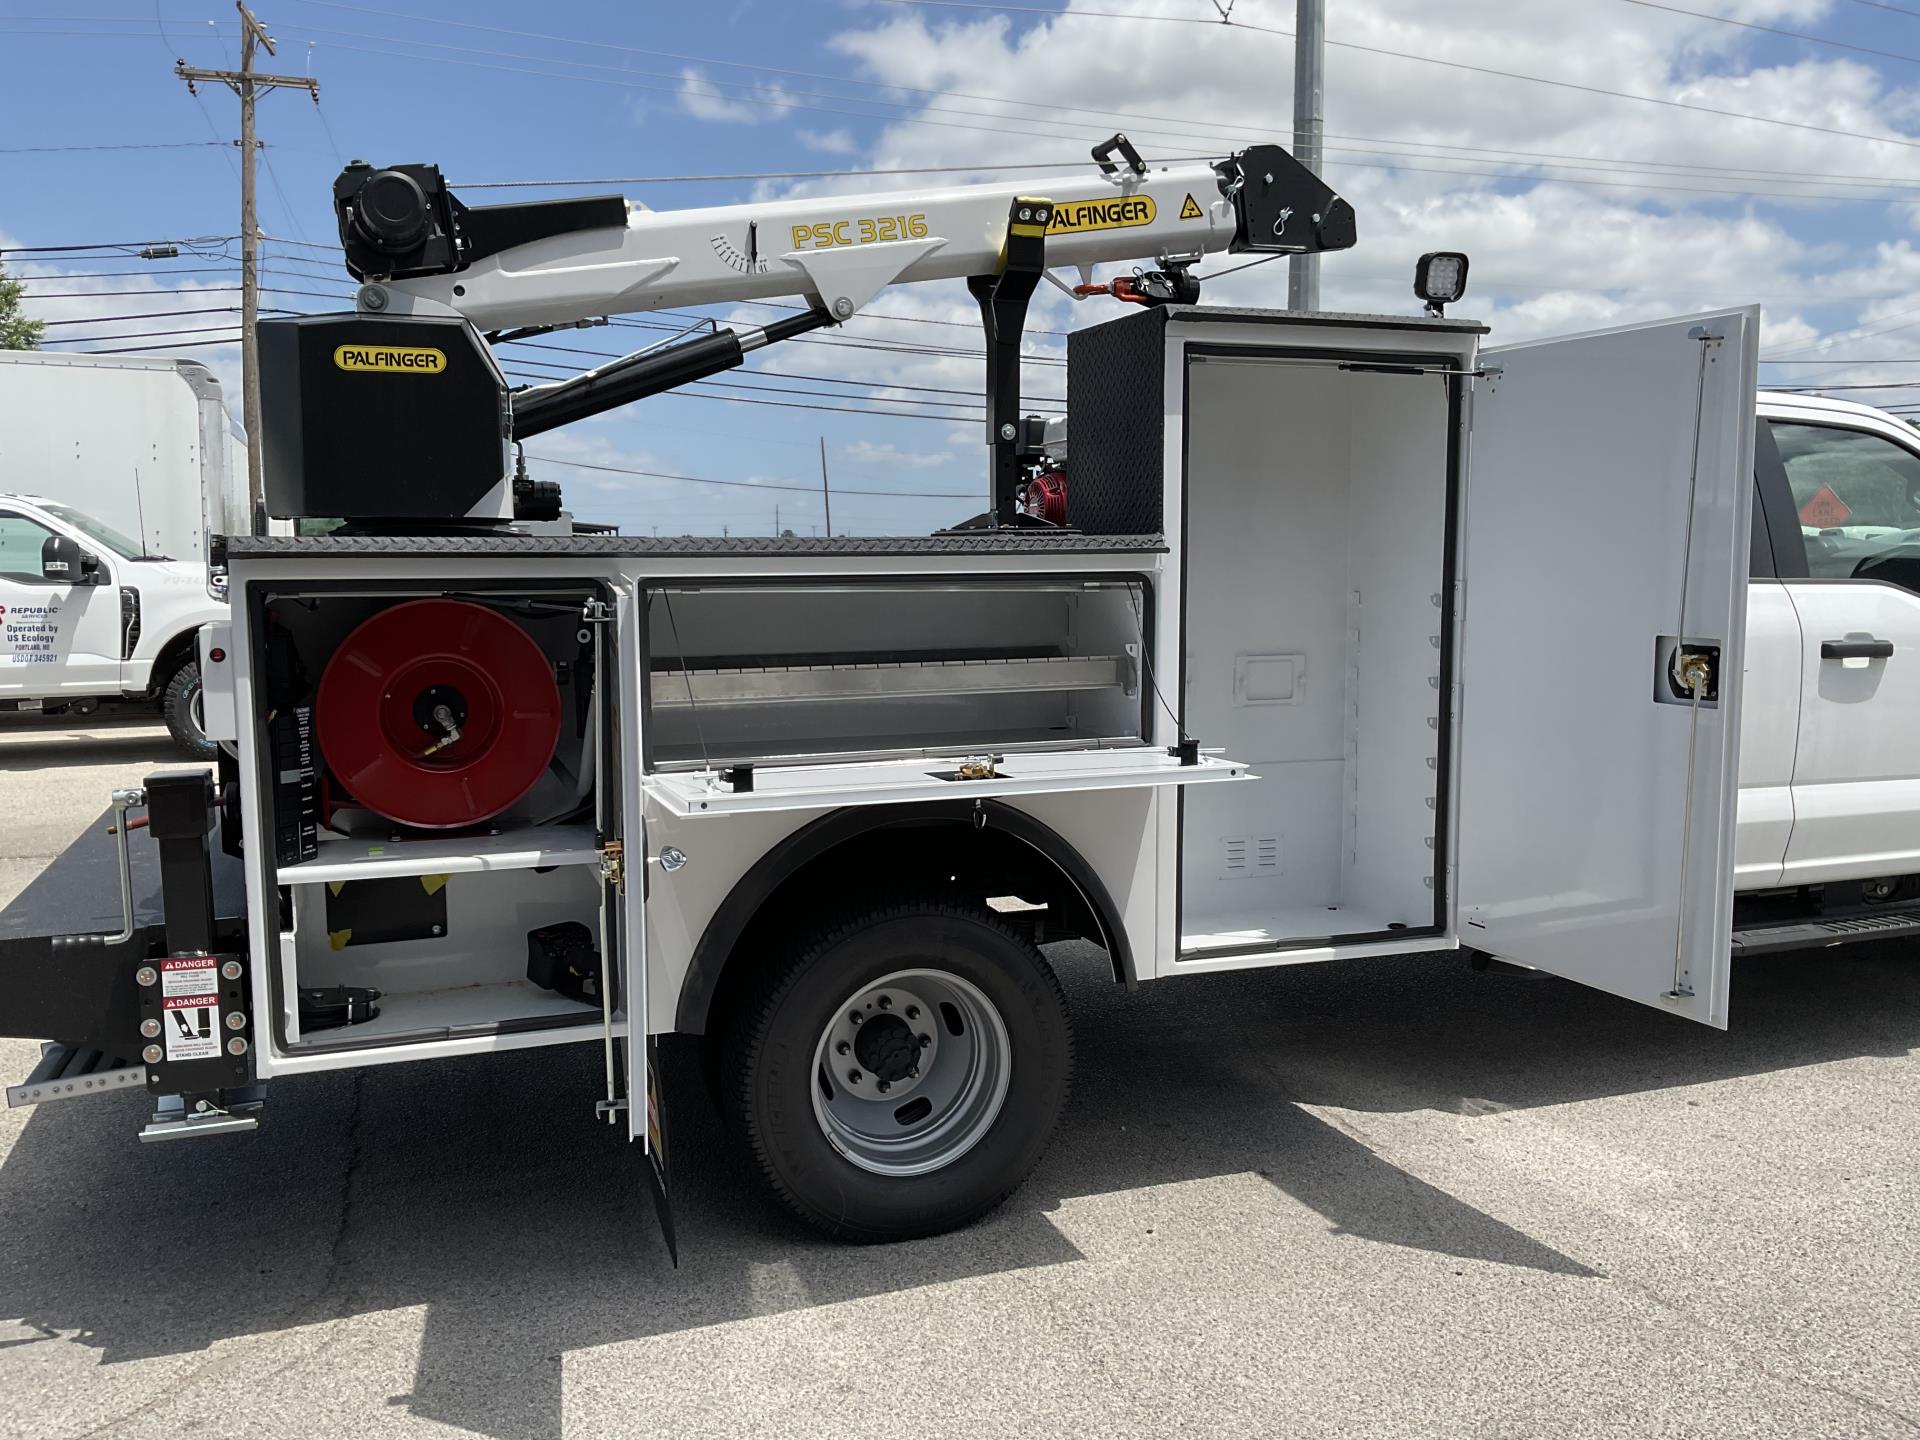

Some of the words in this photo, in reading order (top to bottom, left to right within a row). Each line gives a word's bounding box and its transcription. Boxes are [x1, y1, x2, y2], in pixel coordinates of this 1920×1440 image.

[1051, 201, 1149, 229] ALFINGER
[791, 221, 853, 250] PSC
[857, 214, 929, 243] 3216
[343, 351, 438, 368] PALFINGER
[6, 624, 46, 633] Operated
[48, 624, 59, 633] by
[7, 634, 19, 642] US
[21, 634, 55, 643] Ecology
[175, 959, 214, 969] DANGER
[176, 997, 216, 1007] DANGER
